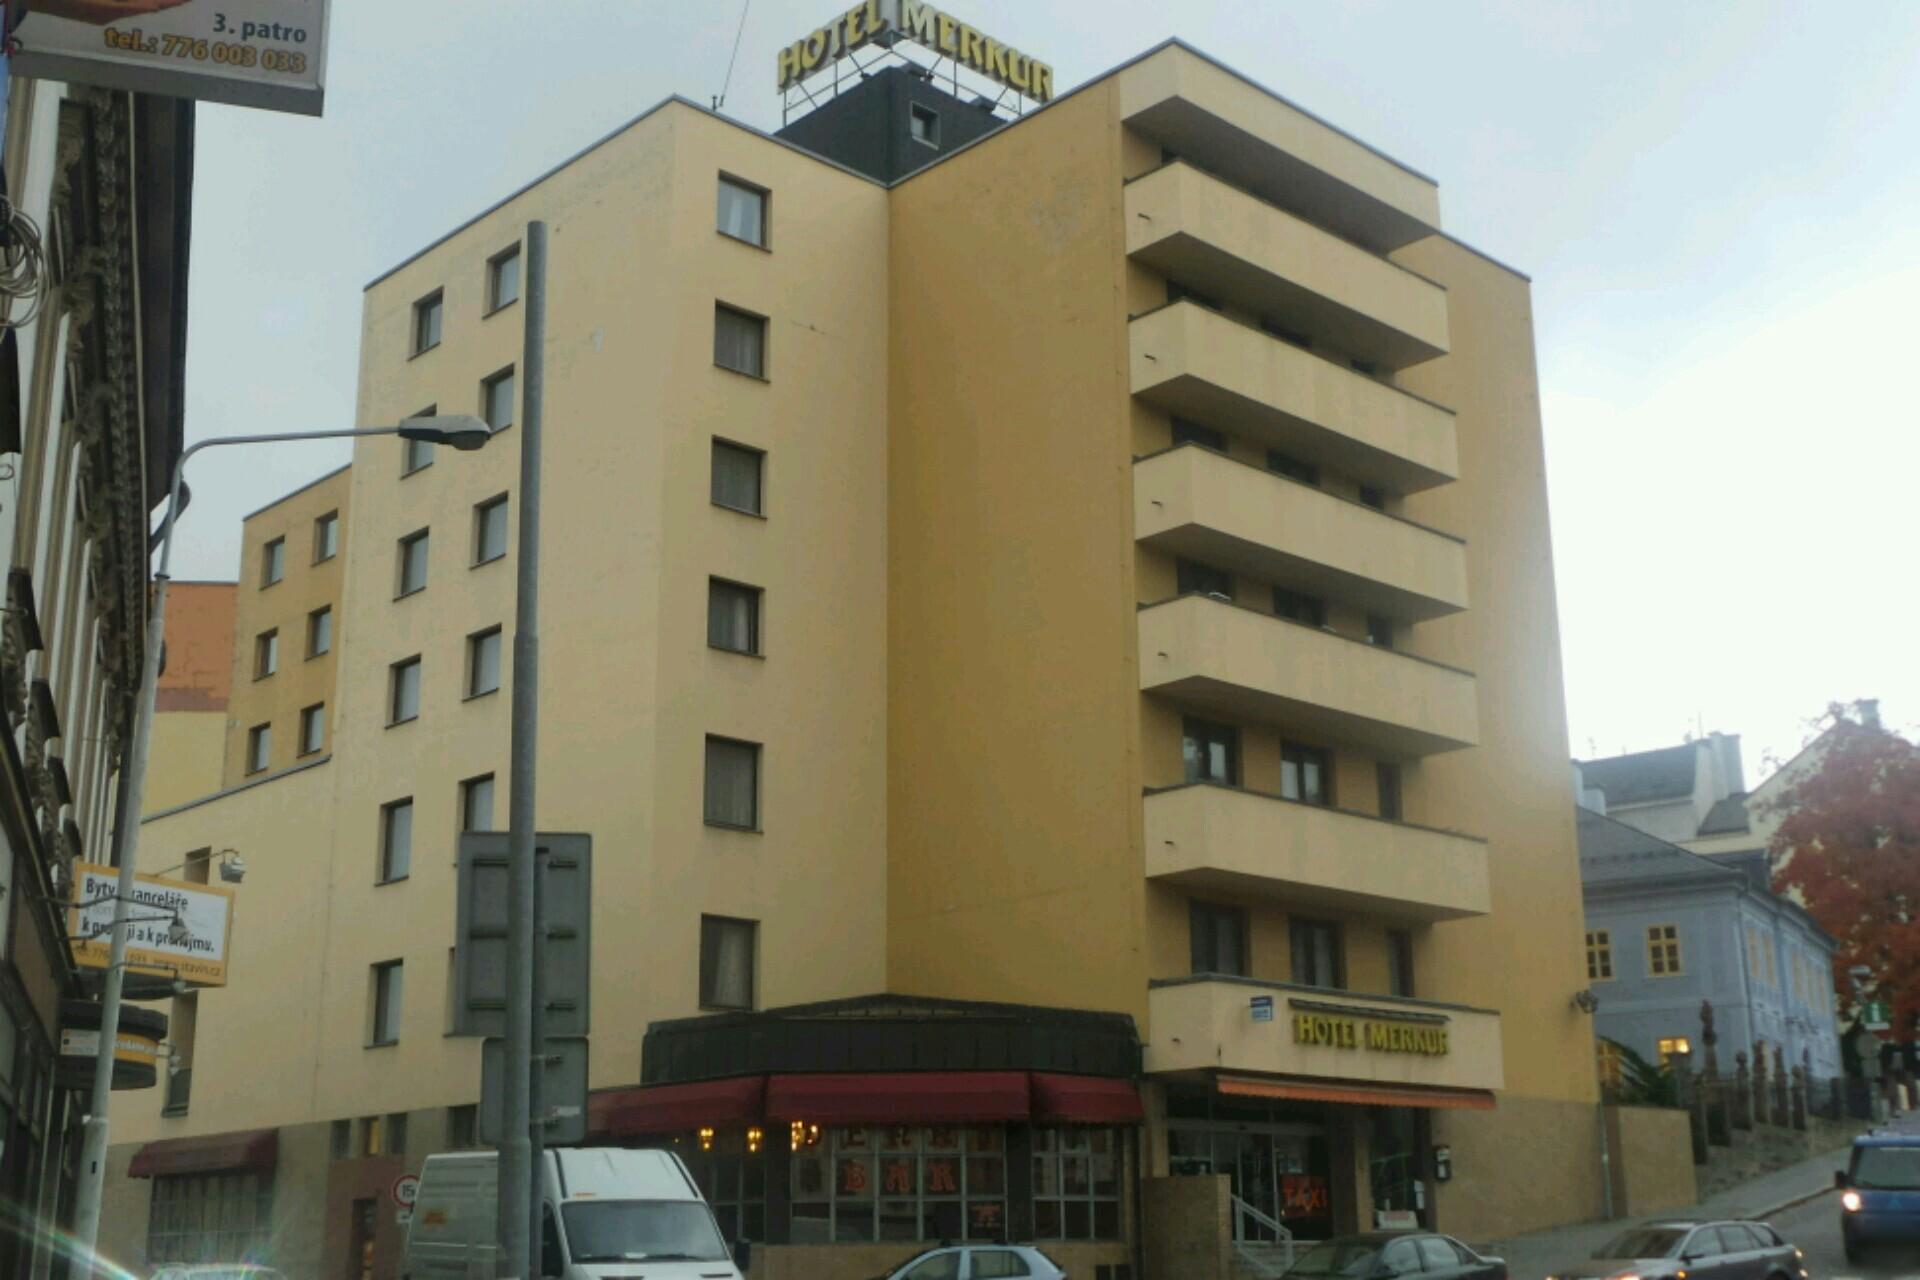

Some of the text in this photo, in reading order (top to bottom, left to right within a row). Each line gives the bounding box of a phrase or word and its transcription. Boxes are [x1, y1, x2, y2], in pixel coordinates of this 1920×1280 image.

[213, 13, 307, 43] 3. patro
[162, 34, 208, 61] 776
[211, 41, 257, 68] 003
[260, 48, 307, 74] 033
[777, 0, 1053, 99] HOTEL MERKUR
[131, 886, 189, 907] anceláře
[82, 915, 90, 932] k
[136, 928, 145, 941] a
[146, 925, 154, 942] k
[1295, 1013, 1449, 1056] HOTEL MERKUR
[845, 1163, 956, 1191] BAR
